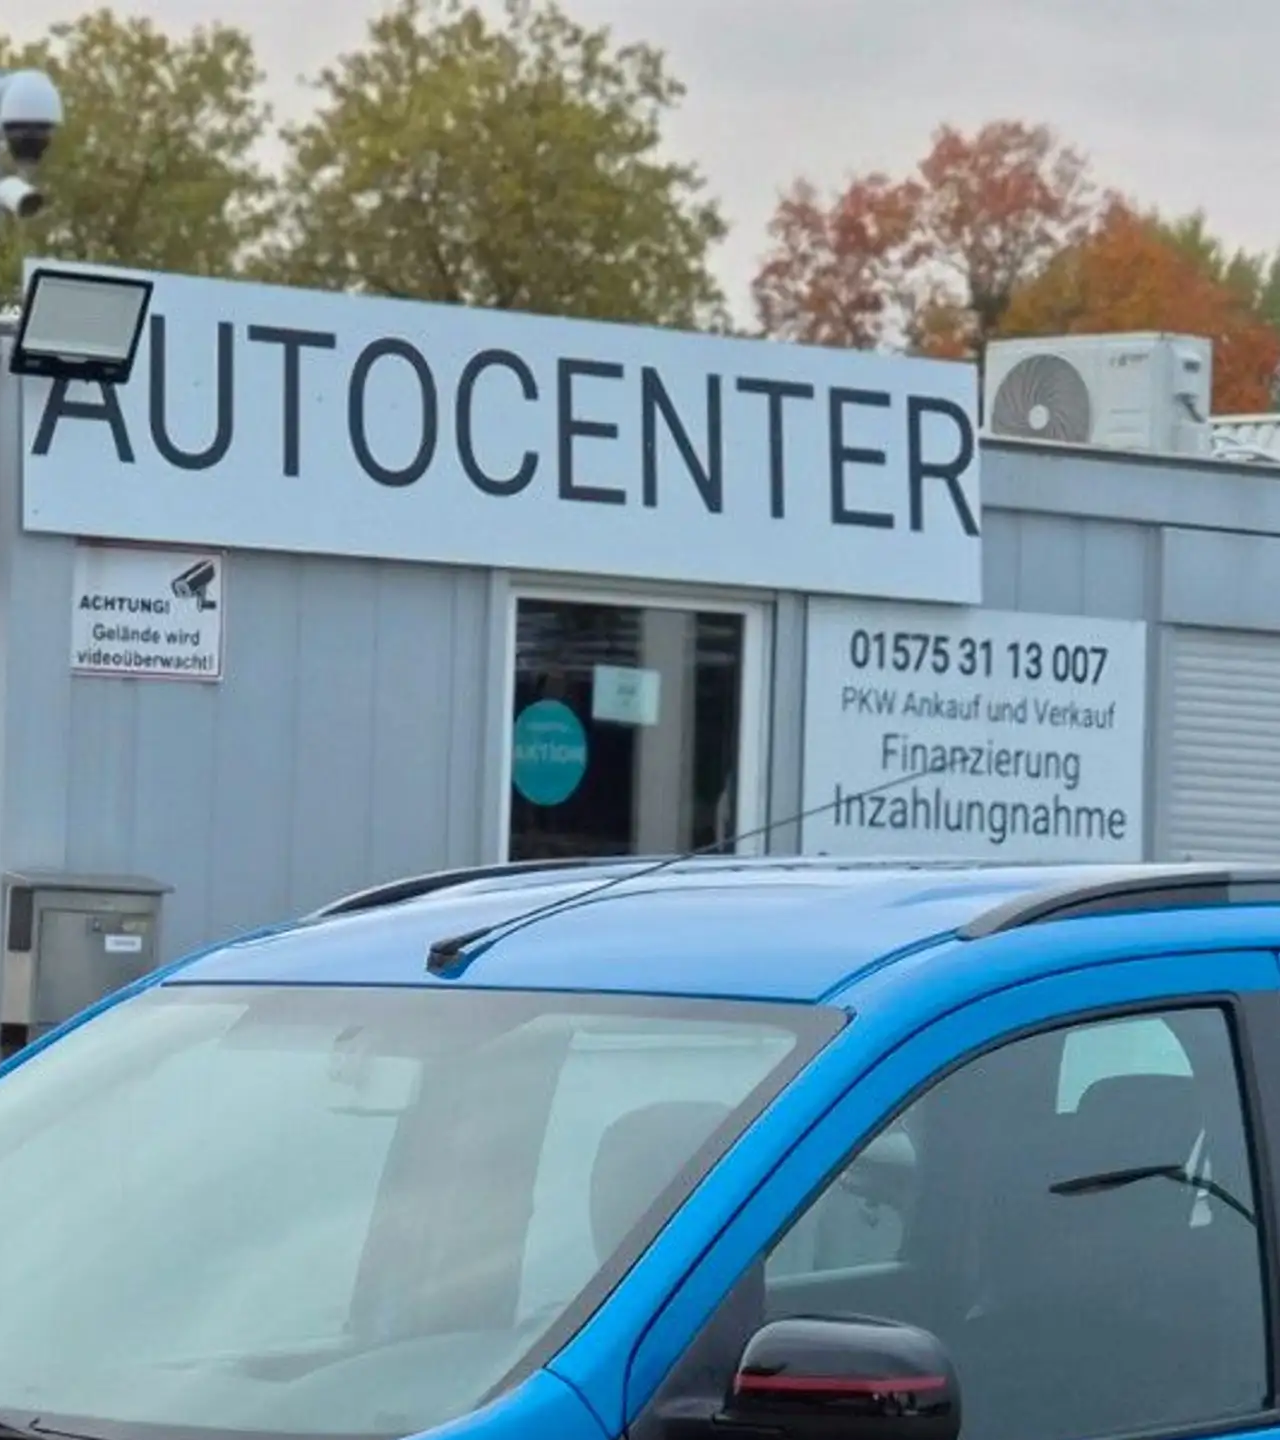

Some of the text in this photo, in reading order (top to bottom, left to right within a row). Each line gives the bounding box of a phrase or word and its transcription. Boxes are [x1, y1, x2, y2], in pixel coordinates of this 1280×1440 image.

[31, 315, 979, 536] AUTOCENTER
[79, 595, 170, 614] ACHTUNG!
[92, 623, 200, 646] Gelände wird
[851, 629, 1109, 685] 01575 31 13 007
[77, 649, 214, 670] videoüberwacht!
[841, 687, 1116, 729] PKW Ankauf und Verkauf
[882, 733, 1081, 790] Finanzierung
[834, 784, 1127, 844] Inzahlungnahme
